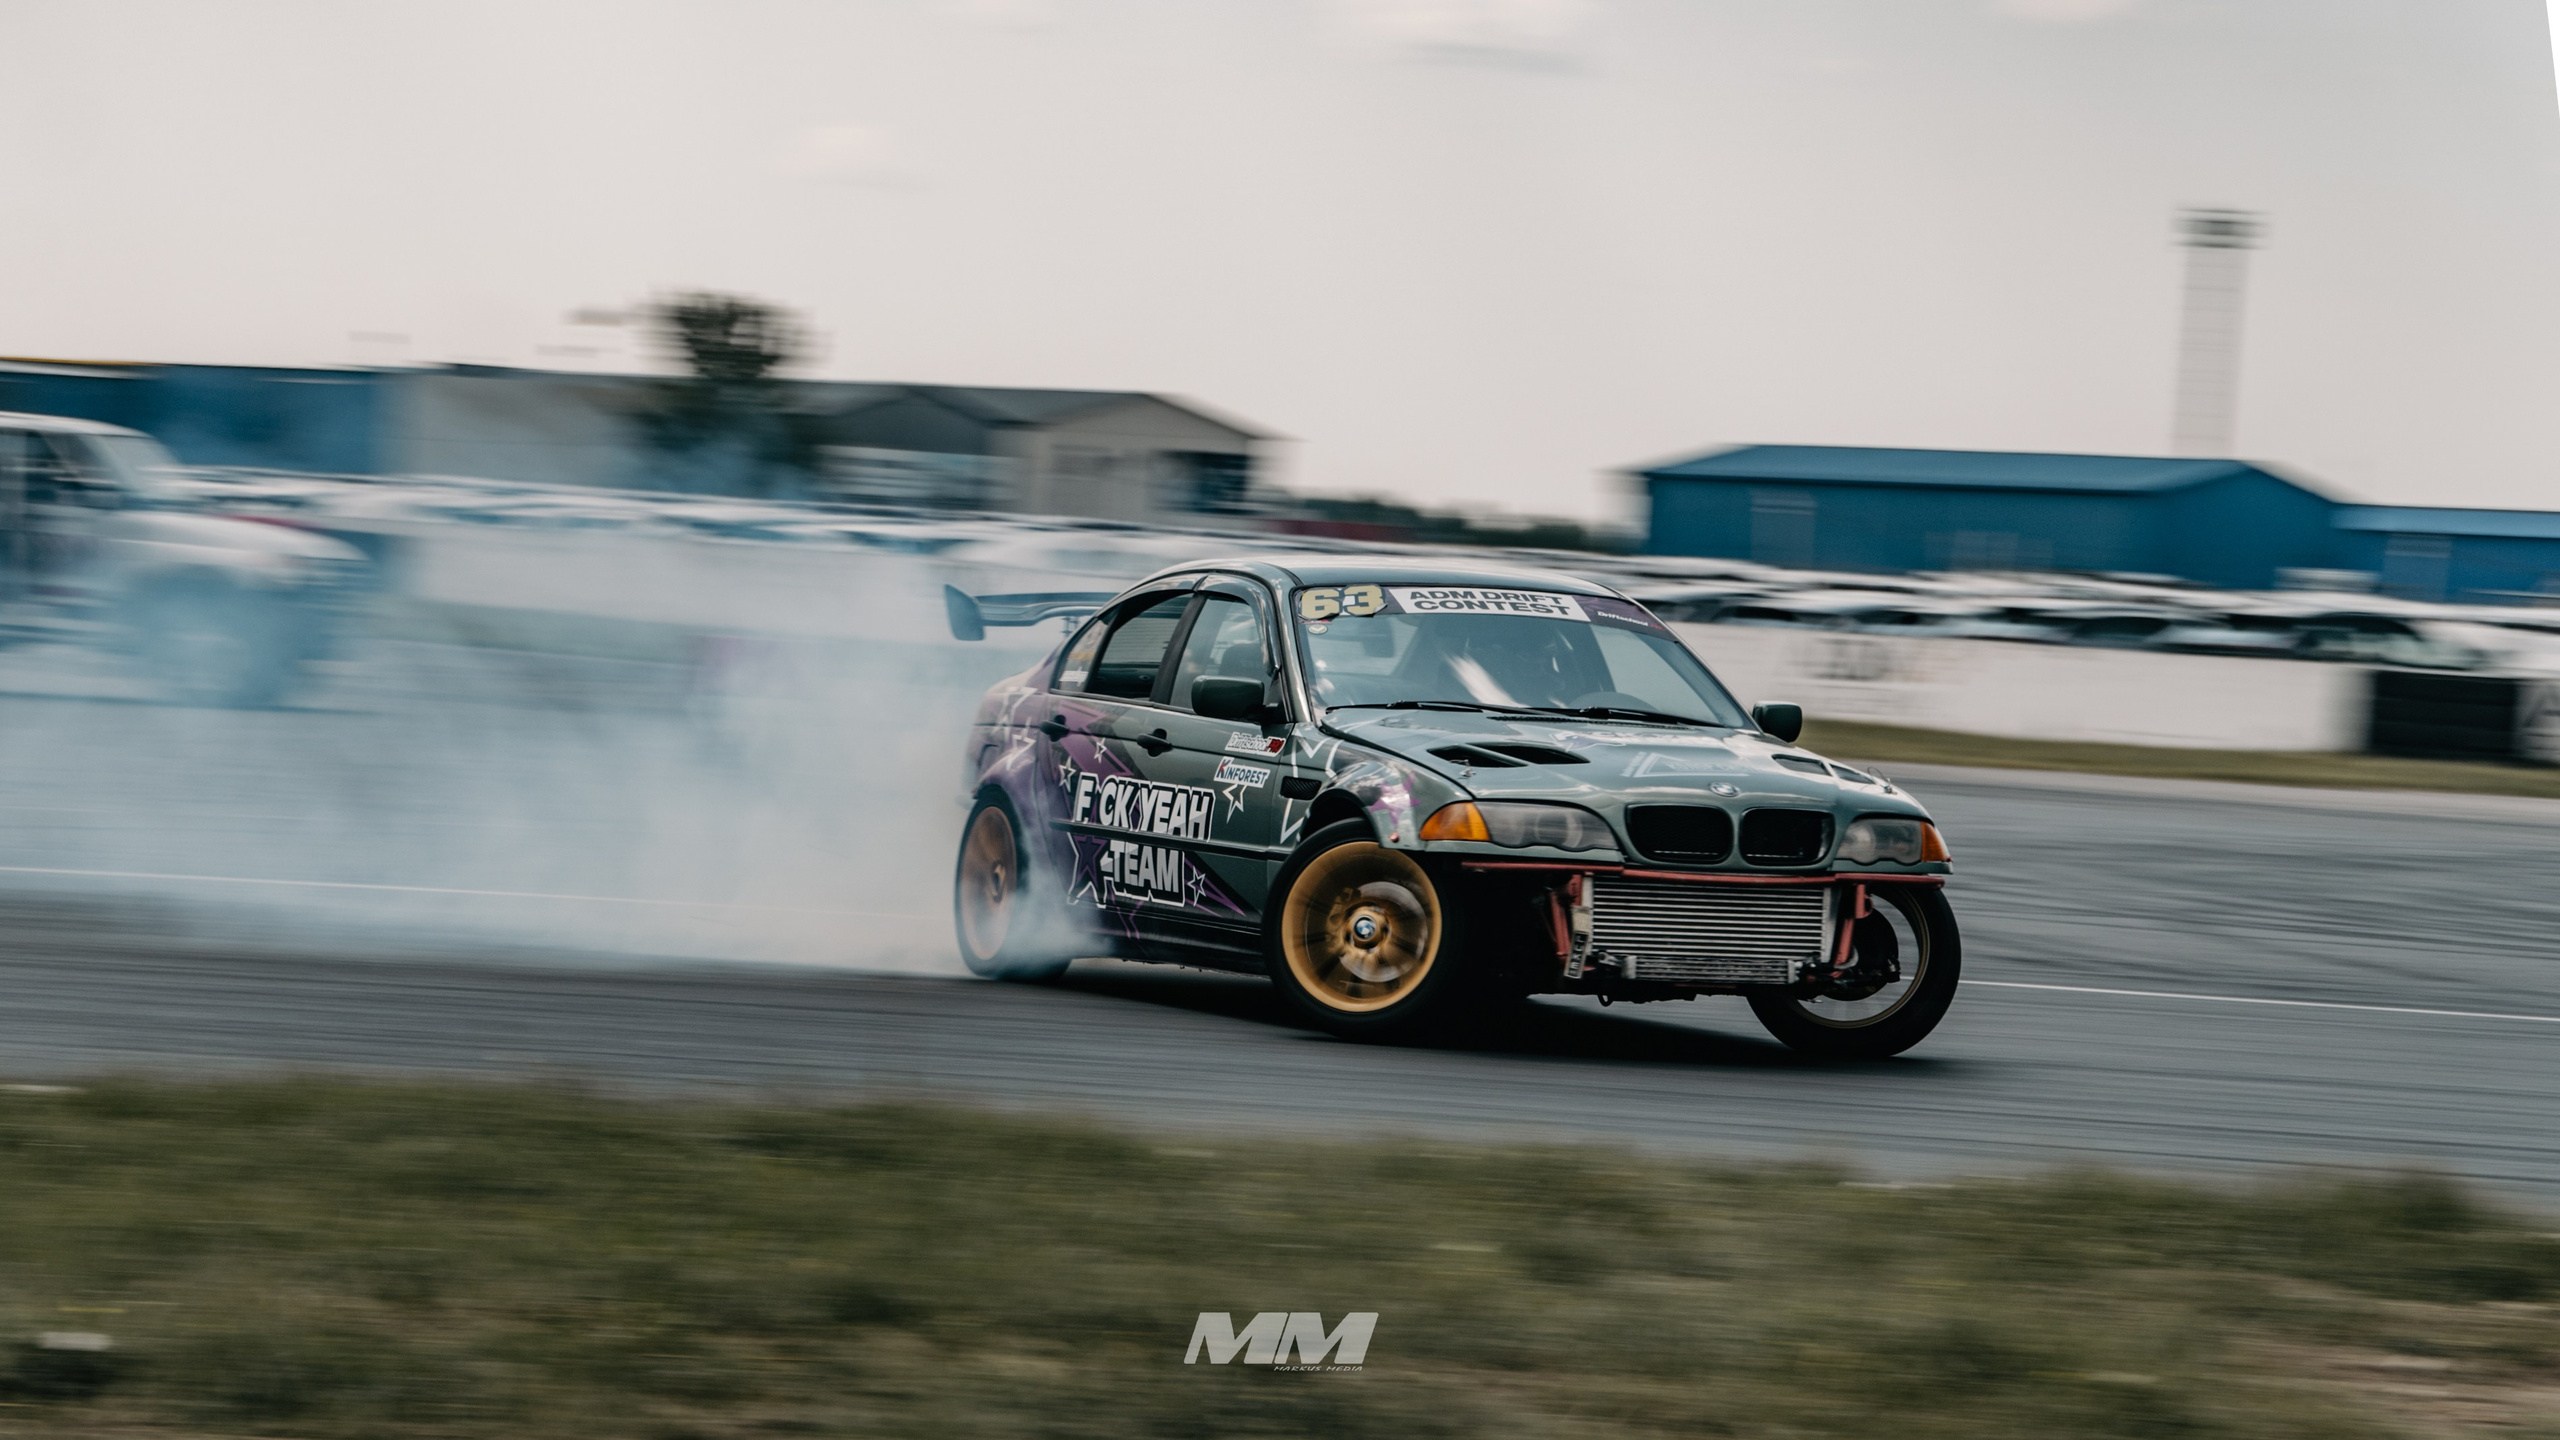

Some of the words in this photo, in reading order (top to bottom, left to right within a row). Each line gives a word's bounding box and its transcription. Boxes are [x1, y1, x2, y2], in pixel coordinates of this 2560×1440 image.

[1299, 585, 1386, 620] 63
[1410, 590, 1473, 600] ADM
[1480, 591, 1562, 605] DRIFT
[1414, 600, 1570, 615] CONTEST
[1140, 787, 1210, 840] YEAH
[1109, 840, 1180, 893] TEAM
